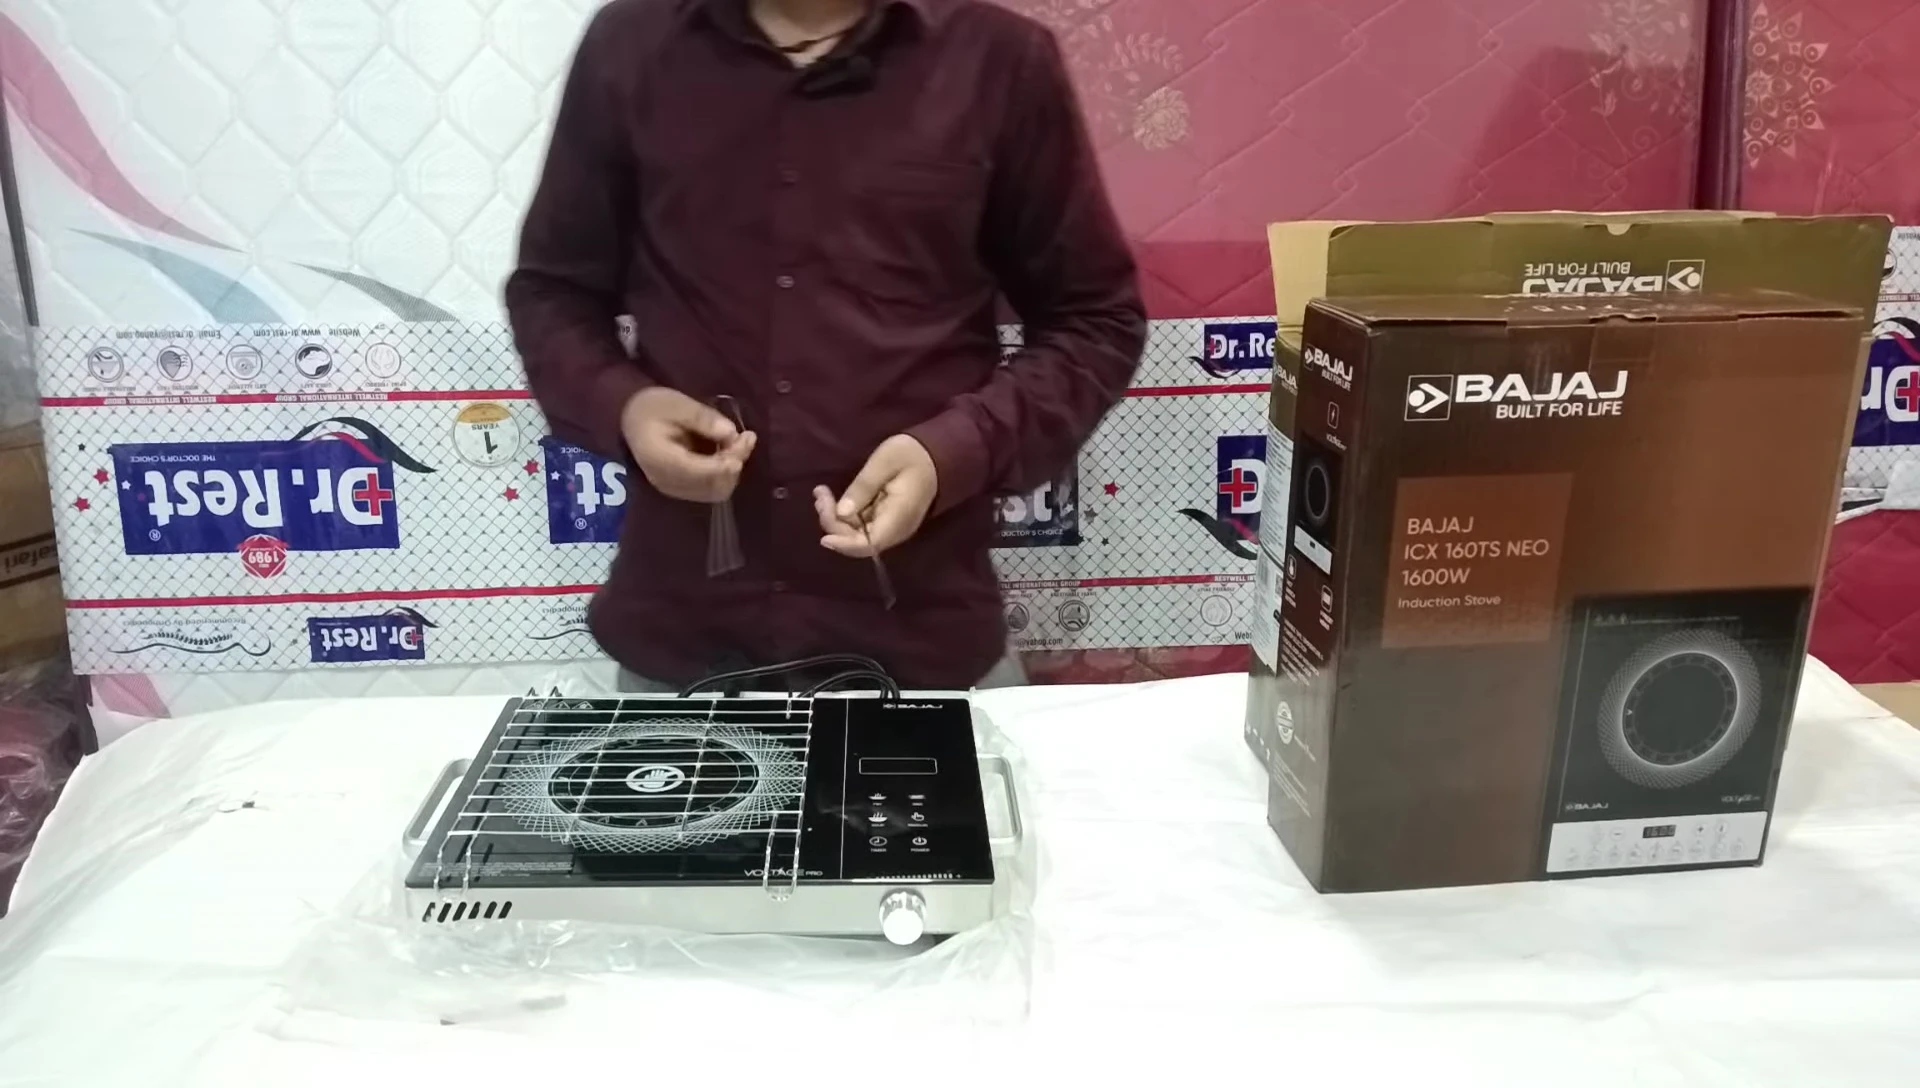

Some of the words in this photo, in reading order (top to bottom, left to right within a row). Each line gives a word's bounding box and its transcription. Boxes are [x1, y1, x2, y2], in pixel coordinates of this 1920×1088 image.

[1524, 263, 1554, 276] LIFE
[1558, 262, 1588, 275] FOR
[1591, 261, 1631, 274] BUILT
[1313, 347, 1353, 382] BAJAJ
[1456, 371, 1628, 402] BAJAJ
[275, 394, 297, 402] GROUP
[299, 393, 353, 402] INTERNATIONAL
[1495, 403, 1543, 421] BUILT
[1548, 402, 1584, 418] FOR
[1588, 400, 1623, 416] LIFE
[471, 423, 500, 431] YEARS
[484, 431, 498, 454] 1
[130, 455, 159, 463] CHOICE
[160, 454, 200, 462] DOCTOR'S
[202, 454, 216, 462] THE
[1038, 528, 1064, 536] CHOICE
[1408, 516, 1474, 535] BAJAJ
[1404, 542, 1438, 560] ICX
[1445, 541, 1501, 559] 160TS
[1505, 539, 1549, 557] NEO
[248, 551, 279, 564] 1989
[1402, 568, 1470, 586] 1600W
[1398, 596, 1462, 610] Induction
[1465, 593, 1502, 607] Stove
[1574, 802, 1610, 811] BAJAJ
